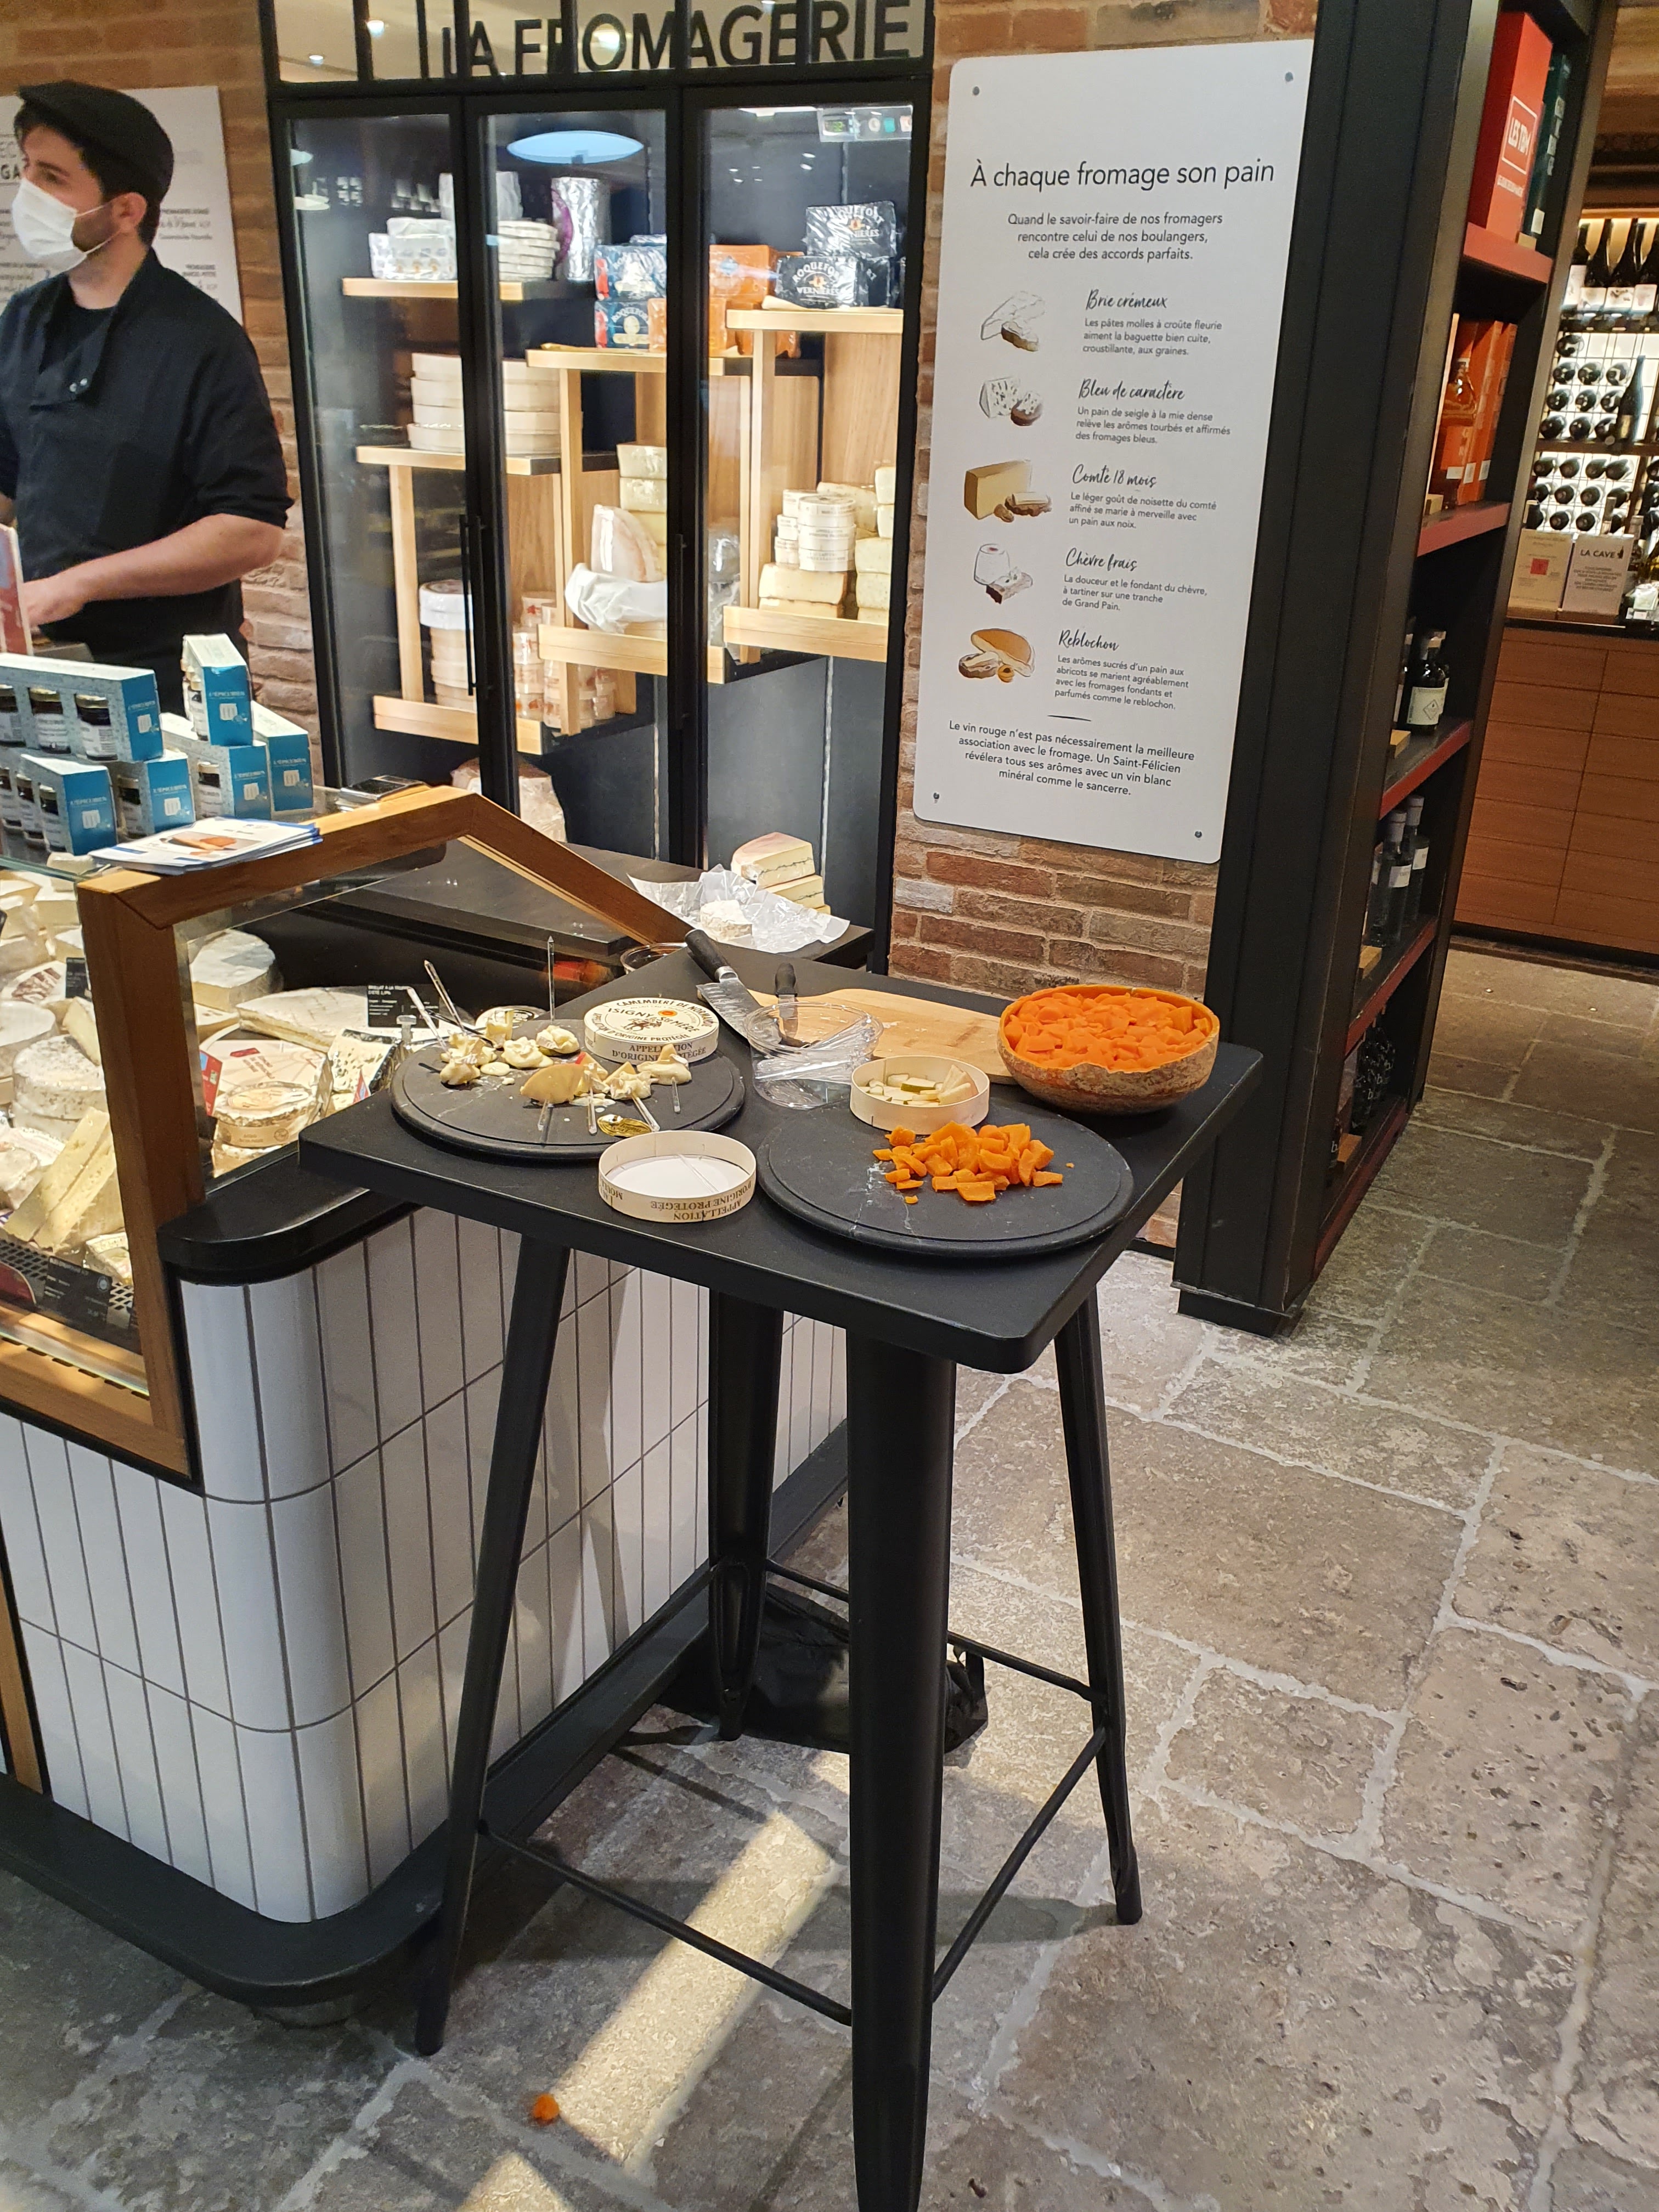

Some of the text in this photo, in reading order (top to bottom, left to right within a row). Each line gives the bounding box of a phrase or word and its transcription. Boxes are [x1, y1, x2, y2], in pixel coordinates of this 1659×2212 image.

[970, 158, 1274, 193] À chaque fromage son pain
[1008, 211, 1223, 228] Quand le savoir-faire de nos fromagers
[1018, 229, 1208, 245] rencontre celui de nos boulangers,
[1028, 246, 1193, 263] cela crée des accords parfaits.
[1086, 289, 1168, 311] Brie crémeux
[1085, 318, 1222, 330] Les pâtes molles à croûte fleurie
[1084, 331, 1211, 344] aiment la baguette bien cuite,
[1078, 379, 1185, 400] Bleu de caractère
[1077, 406, 1213, 421] Un pain de seigle à la mie dense
[1076, 419, 1102, 428] relève
[1103, 419, 1115, 429] les
[1117, 421, 1148, 431] arômes
[1150, 423, 1183, 432] tourbés
[1195, 424, 1231, 435] affirmés
[1072, 464, 1157, 488] Comté 18 mois
[1070, 492, 1217, 510] Le léger goût de noisette du comté
[1069, 503, 1092, 514] affiné
[1105, 507, 1128, 516] marie
[1130, 507, 1136, 516] à
[1137, 510, 1175, 520] merveille
[1080, 517, 1098, 527] pain
[1116, 520, 1136, 529] noix.
[1065, 548, 1137, 572] Chèvre frais
[1593, 550, 1617, 558] CAVE
[1063, 585, 1068, 594] à
[1070, 588, 1099, 597] tartiner
[1132, 593, 1163, 603] tranche
[1064, 574, 1073, 583] La
[1075, 575, 1109, 586] douceur
[1120, 579, 1128, 588] le
[1130, 579, 1163, 591] fondant
[1164, 583, 1176, 592] du
[1177, 584, 1207, 596] chèvre,
[1062, 597, 1120, 611] de Grand Pain.
[1058, 629, 1119, 651] Reblochon
[1058, 654, 1070, 663] Les
[1072, 657, 1101, 667] arômes
[1103, 661, 1128, 670] sucrés
[1129, 662, 1148, 672] d'un
[1149, 665, 1167, 674] pain
[1056, 665, 1087, 676] abricots
[1100, 672, 1131, 682] marient
[1132, 675, 1189, 688] agréablement
[1075, 679, 1086, 688] les
[1088, 680, 1125, 693] fromages
[1127, 684, 1162, 697] fondants
[1054, 689, 1176, 710] parfumés comme le reblochon.
[949, 720, 1195, 760] Le vin rouge n'est pas nécessairement la meilleure
[958, 738, 1181, 774] association avec le fromage. Un Saint-Félicien
[965, 751, 1171, 787] révélera tous ses arômes avec un vin blanc
[999, 769, 1131, 795] minéral comme le sancerre.
[608, 1008, 654, 1018] ISIGNY
[651, 1200, 712, 1212] PROTÉGÉE
[673, 1200, 742, 1221] APPELLATION
